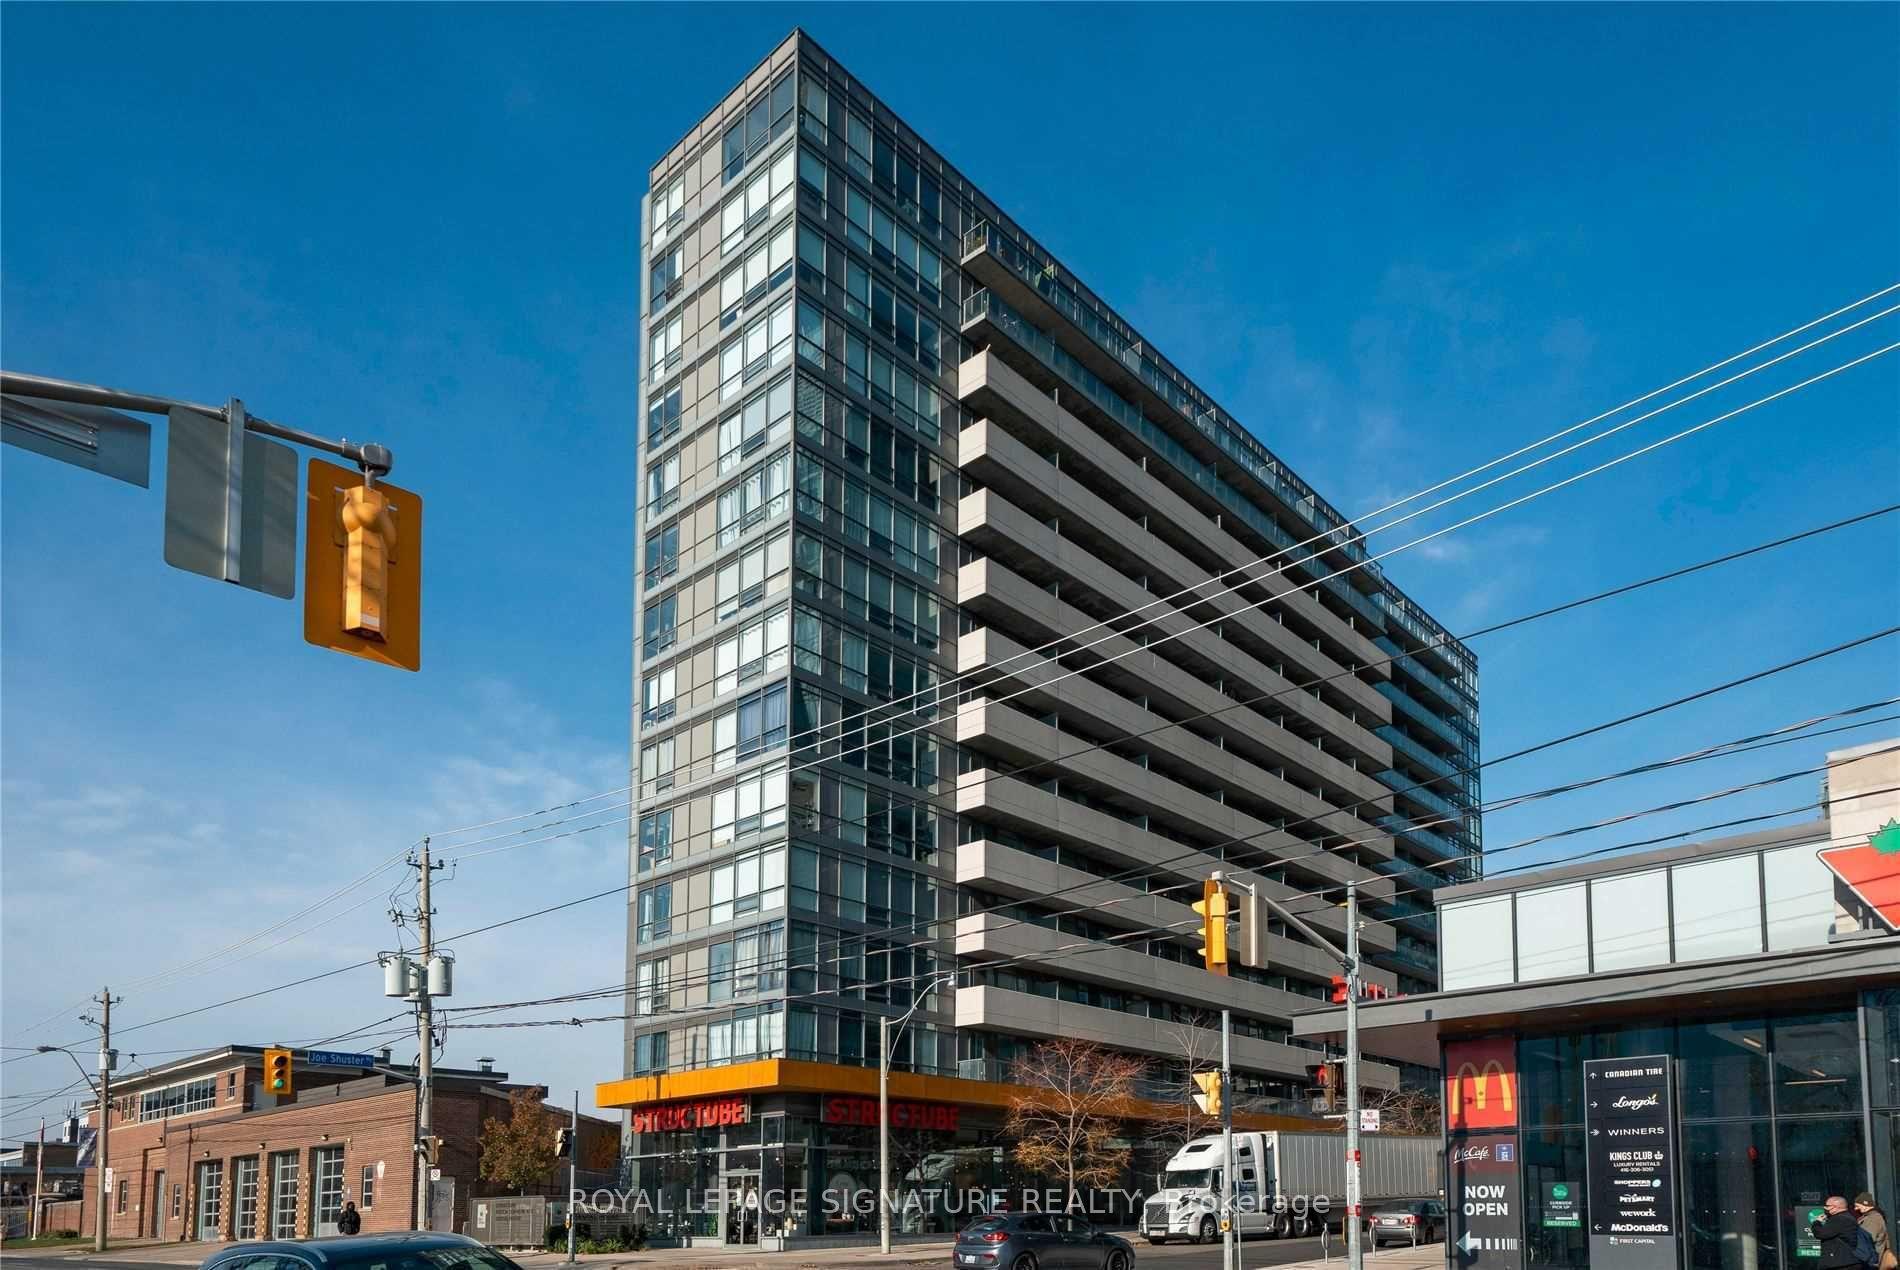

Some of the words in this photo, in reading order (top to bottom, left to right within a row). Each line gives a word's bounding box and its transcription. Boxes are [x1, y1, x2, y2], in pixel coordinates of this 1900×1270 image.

[310, 1053, 327, 1063] Joe
[330, 1054, 364, 1065] Shuster
[1605, 1069, 1643, 1078] CANADIAN
[1612, 1094, 1659, 1110] Longo's
[633, 1099, 747, 1134] STRUCTUBE
[1608, 1127, 1665, 1136] WINNERS
[1609, 1151, 1632, 1161] KINGS
[1633, 1151, 1653, 1160] CLUB
[1464, 1185, 1506, 1199] NOW
[1463, 1202, 1509, 1216] OPEN
[1620, 1208, 1656, 1217] wework
[1610, 1223, 1669, 1232] McDonald's
